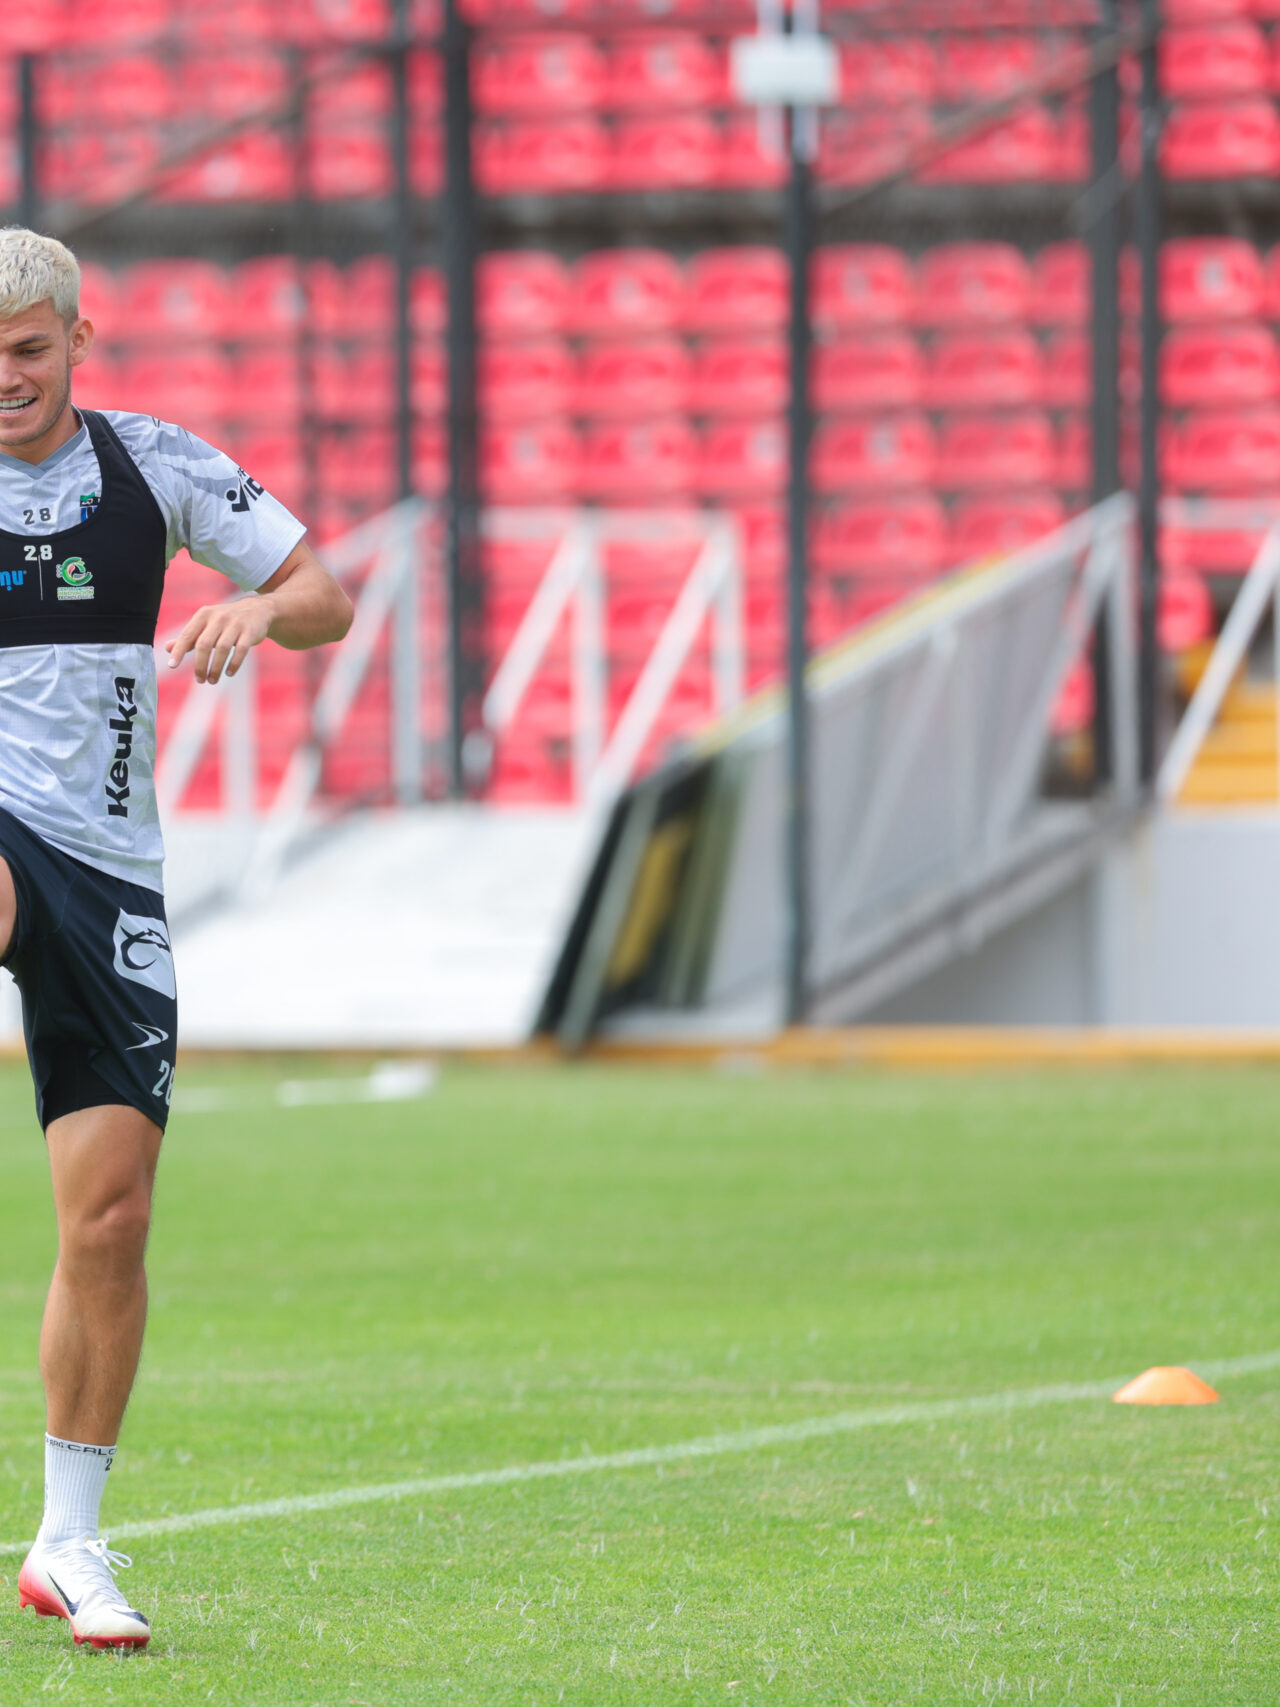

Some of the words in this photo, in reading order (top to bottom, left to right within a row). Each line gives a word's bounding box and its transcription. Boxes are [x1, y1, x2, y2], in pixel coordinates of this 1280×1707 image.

[23, 507, 51, 525] 28
[23, 544, 53, 561] 28
[105, 676, 138, 818] Keuka
